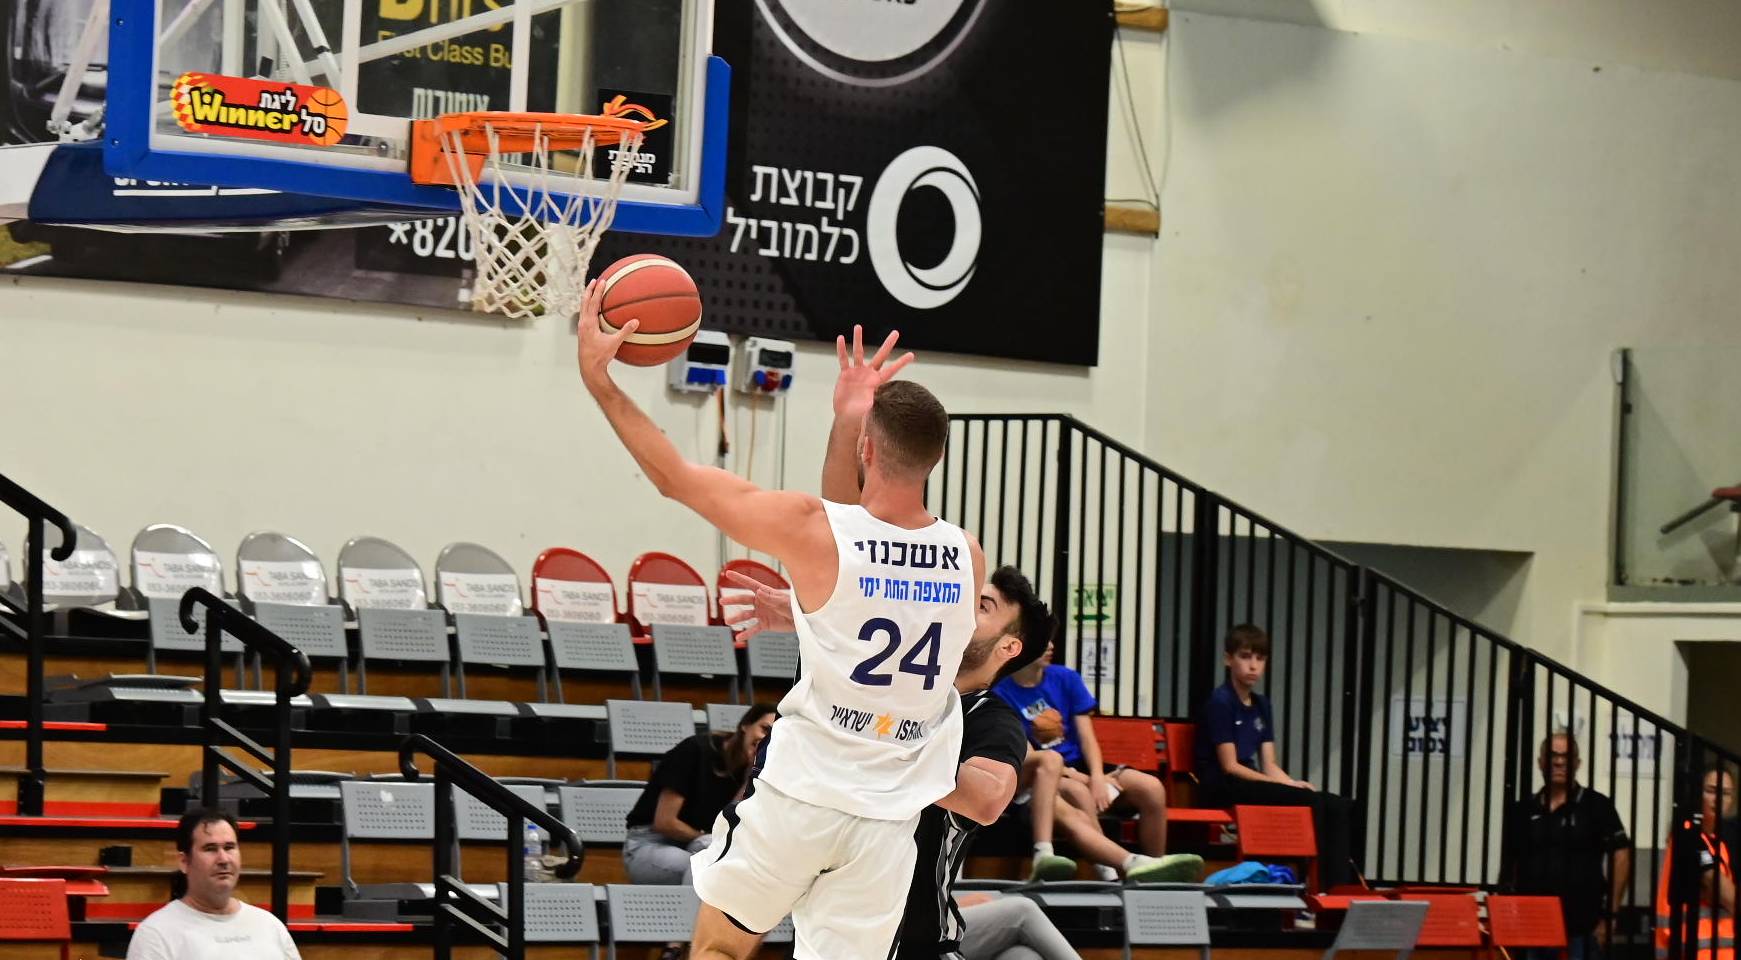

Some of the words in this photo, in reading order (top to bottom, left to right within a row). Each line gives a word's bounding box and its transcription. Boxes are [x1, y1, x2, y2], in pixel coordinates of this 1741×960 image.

[427, 39, 484, 65] Class
[191, 89, 299, 131] Winner
[259, 89, 297, 111] ליגת
[300, 107, 327, 134] סל
[750, 165, 864, 220] קבוצת
[726, 206, 860, 264] כלמוביל
[854, 539, 960, 570] אשכנזי
[859, 576, 880, 598] ימי
[912, 580, 960, 604] המצפה
[849, 617, 943, 691] 24
